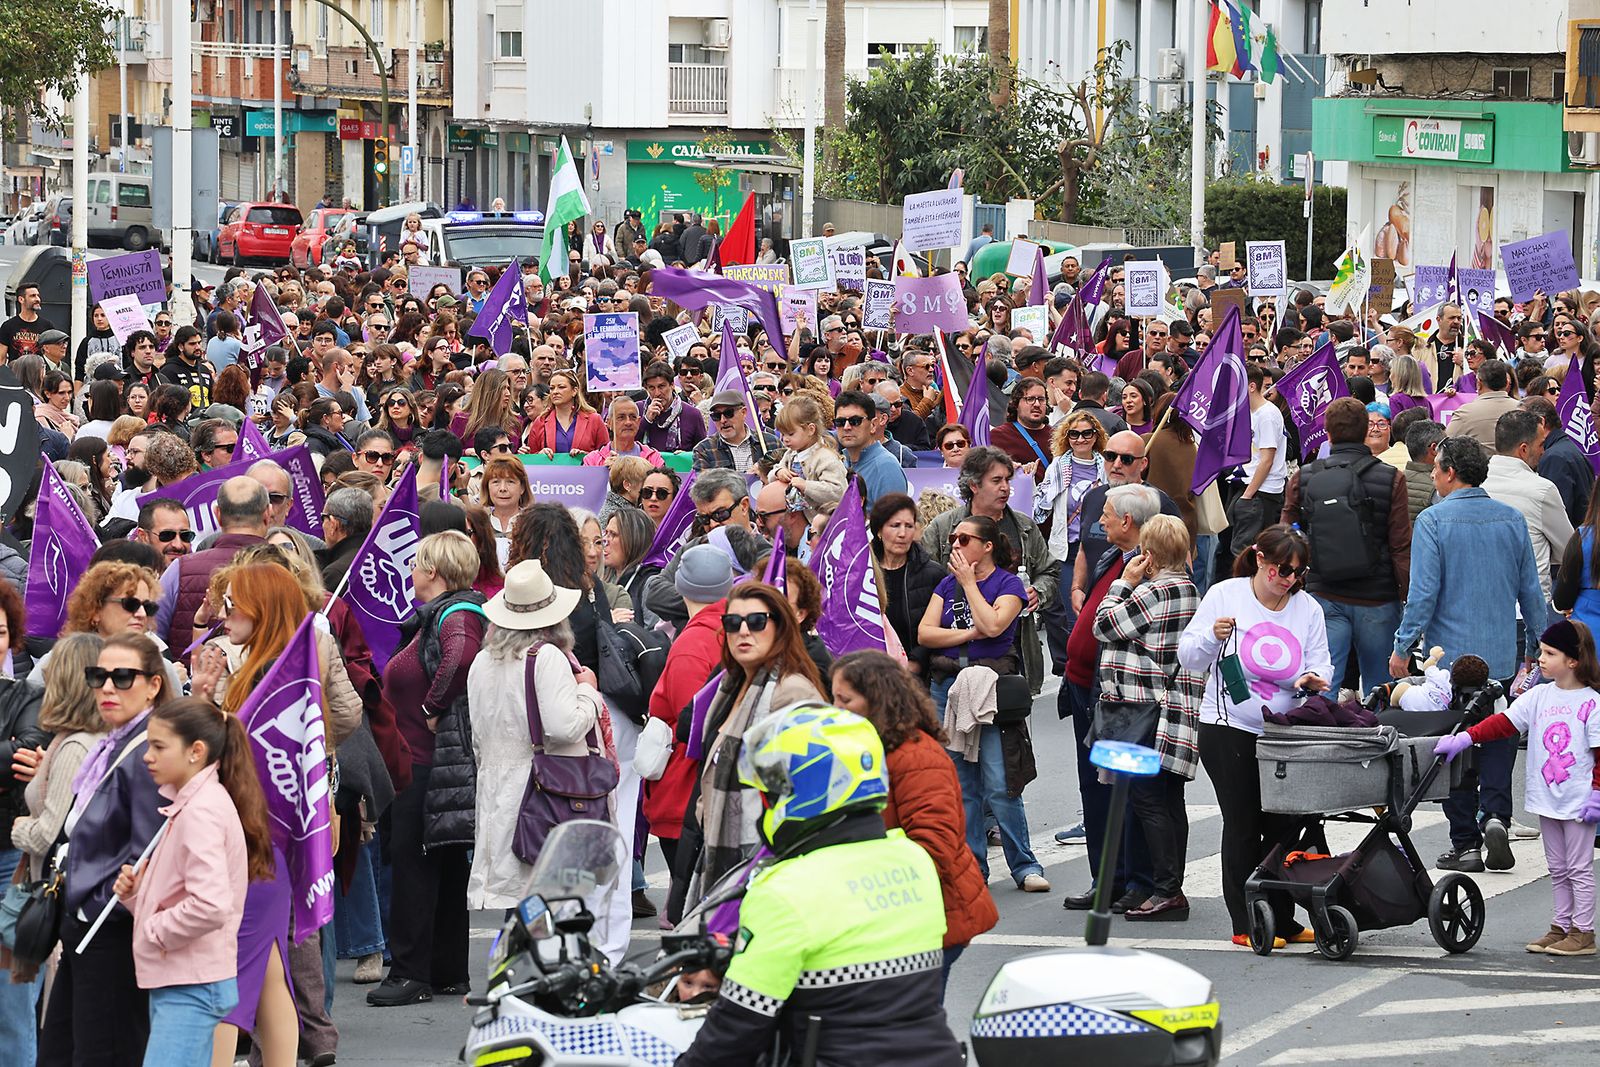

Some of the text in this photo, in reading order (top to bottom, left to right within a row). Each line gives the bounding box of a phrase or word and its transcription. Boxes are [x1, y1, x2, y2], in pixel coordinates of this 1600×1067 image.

[215, 125, 231, 136] 5€
[254, 122, 275, 131] optic
[1418, 132, 1457, 152] COVIRAN
[671, 145, 753, 158] CAJA RAL
[404, 149, 412, 172] P
[799, 246, 815, 258] 8M
[1255, 252, 1272, 261] 8M
[100, 262, 152, 280] FEMINISTA
[1509, 266, 1529, 277] FALTE
[1135, 276, 1149, 284] 8M
[1513, 273, 1569, 295] LES FALTA DE
[103, 279, 162, 299] ANTIFASCISTA
[873, 290, 890, 299] 8M
[790, 298, 807, 306] MATA
[115, 306, 134, 315] MATA
[600, 324, 630, 333] FEMINISMO
[674, 334, 690, 347] 8M
[530, 480, 585, 495] demos
[847, 866, 920, 893] POLICIA
[865, 887, 922, 912] LOCAL
